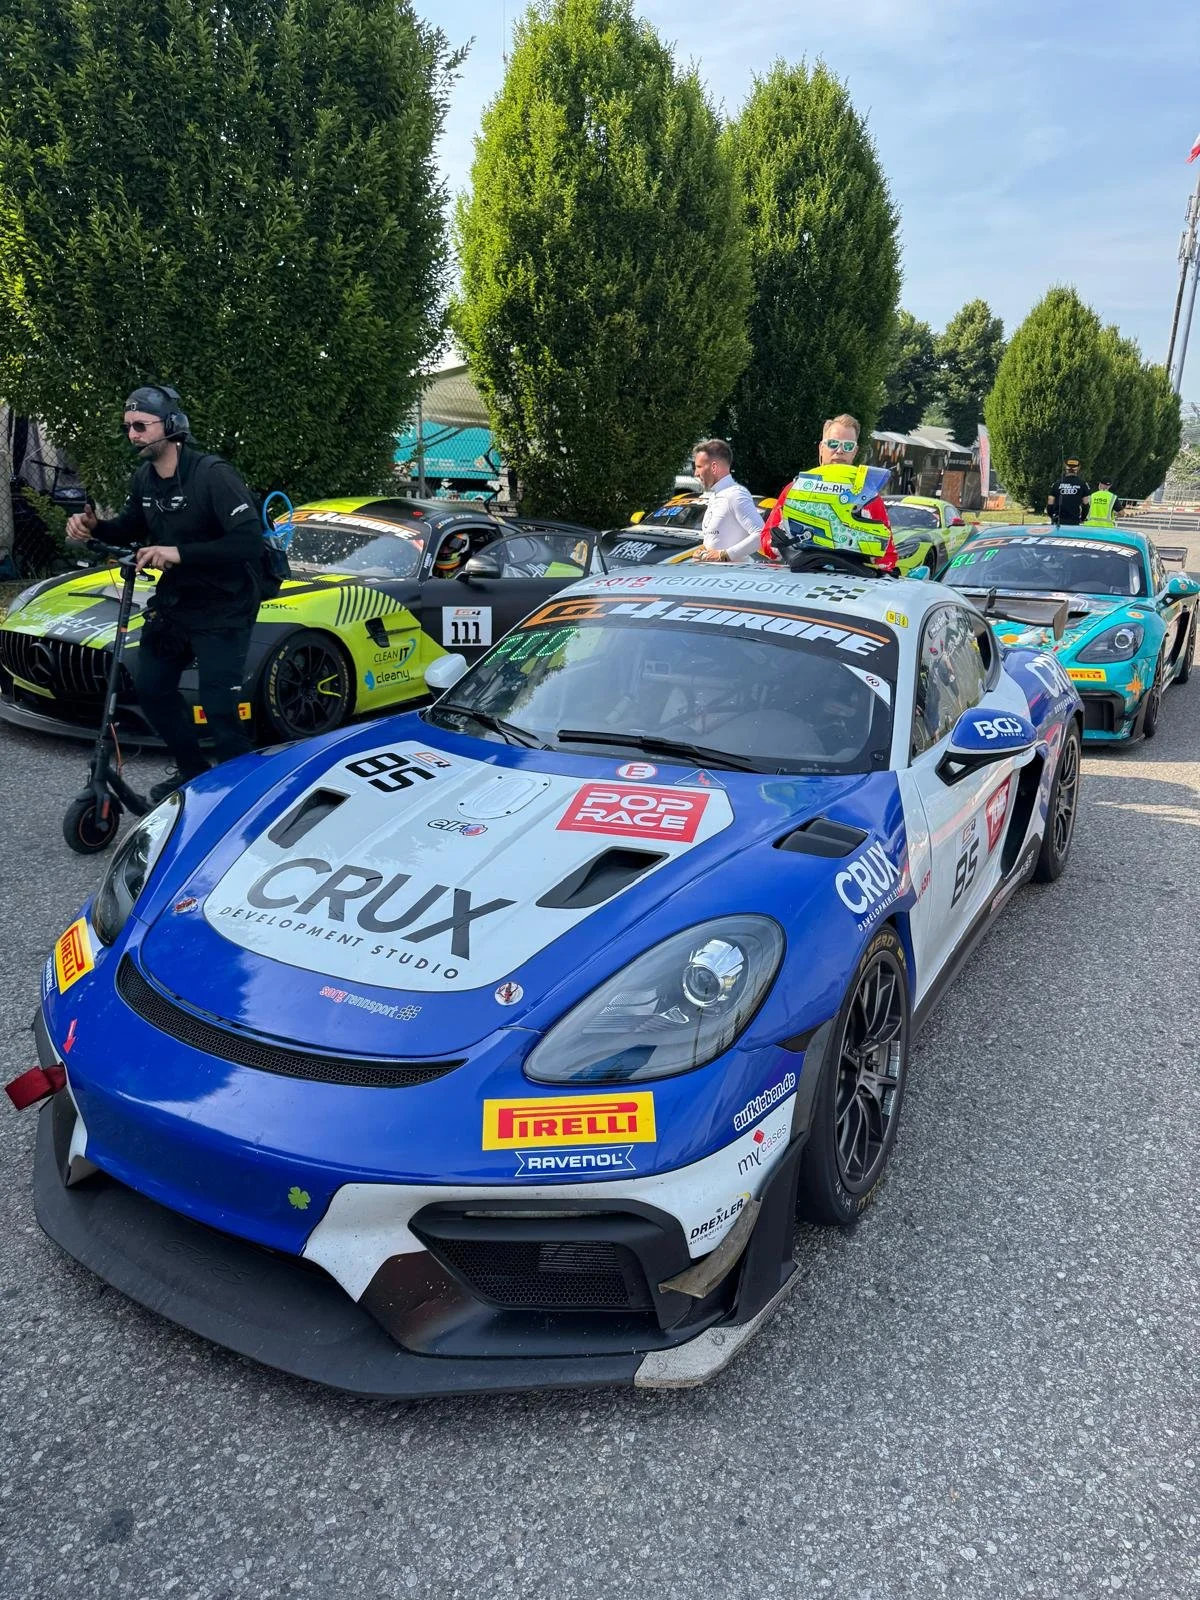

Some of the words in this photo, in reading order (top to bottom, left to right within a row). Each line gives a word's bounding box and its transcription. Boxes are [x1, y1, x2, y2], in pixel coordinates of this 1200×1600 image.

[1034, 541, 1137, 558] EUROPE
[654, 575, 803, 597] rennsport
[451, 621, 481, 644] 111
[660, 607, 883, 656] EUROPE
[373, 651, 399, 663] CLEAN
[399, 647, 411, 661] IT
[376, 669, 410, 684] cleany
[973, 717, 1023, 740] BGS
[345, 752, 437, 793] 85
[583, 791, 694, 813] POP
[427, 818, 466, 834] elf
[574, 807, 689, 830] RACE
[835, 840, 901, 914] CRUX
[246, 857, 519, 961] CRUX
[60, 925, 86, 982] PIRELLI
[218, 906, 365, 948] DEVELOPMENT
[370, 945, 459, 980] STUDIO
[733, 1072, 796, 1132] aufkleben.de
[497, 1101, 639, 1139] PIRELLI
[528, 1153, 624, 1170] RAVENOL
[737, 1146, 762, 1176] my
[761, 1124, 787, 1153] cases
[690, 1198, 744, 1240] DREXLER
